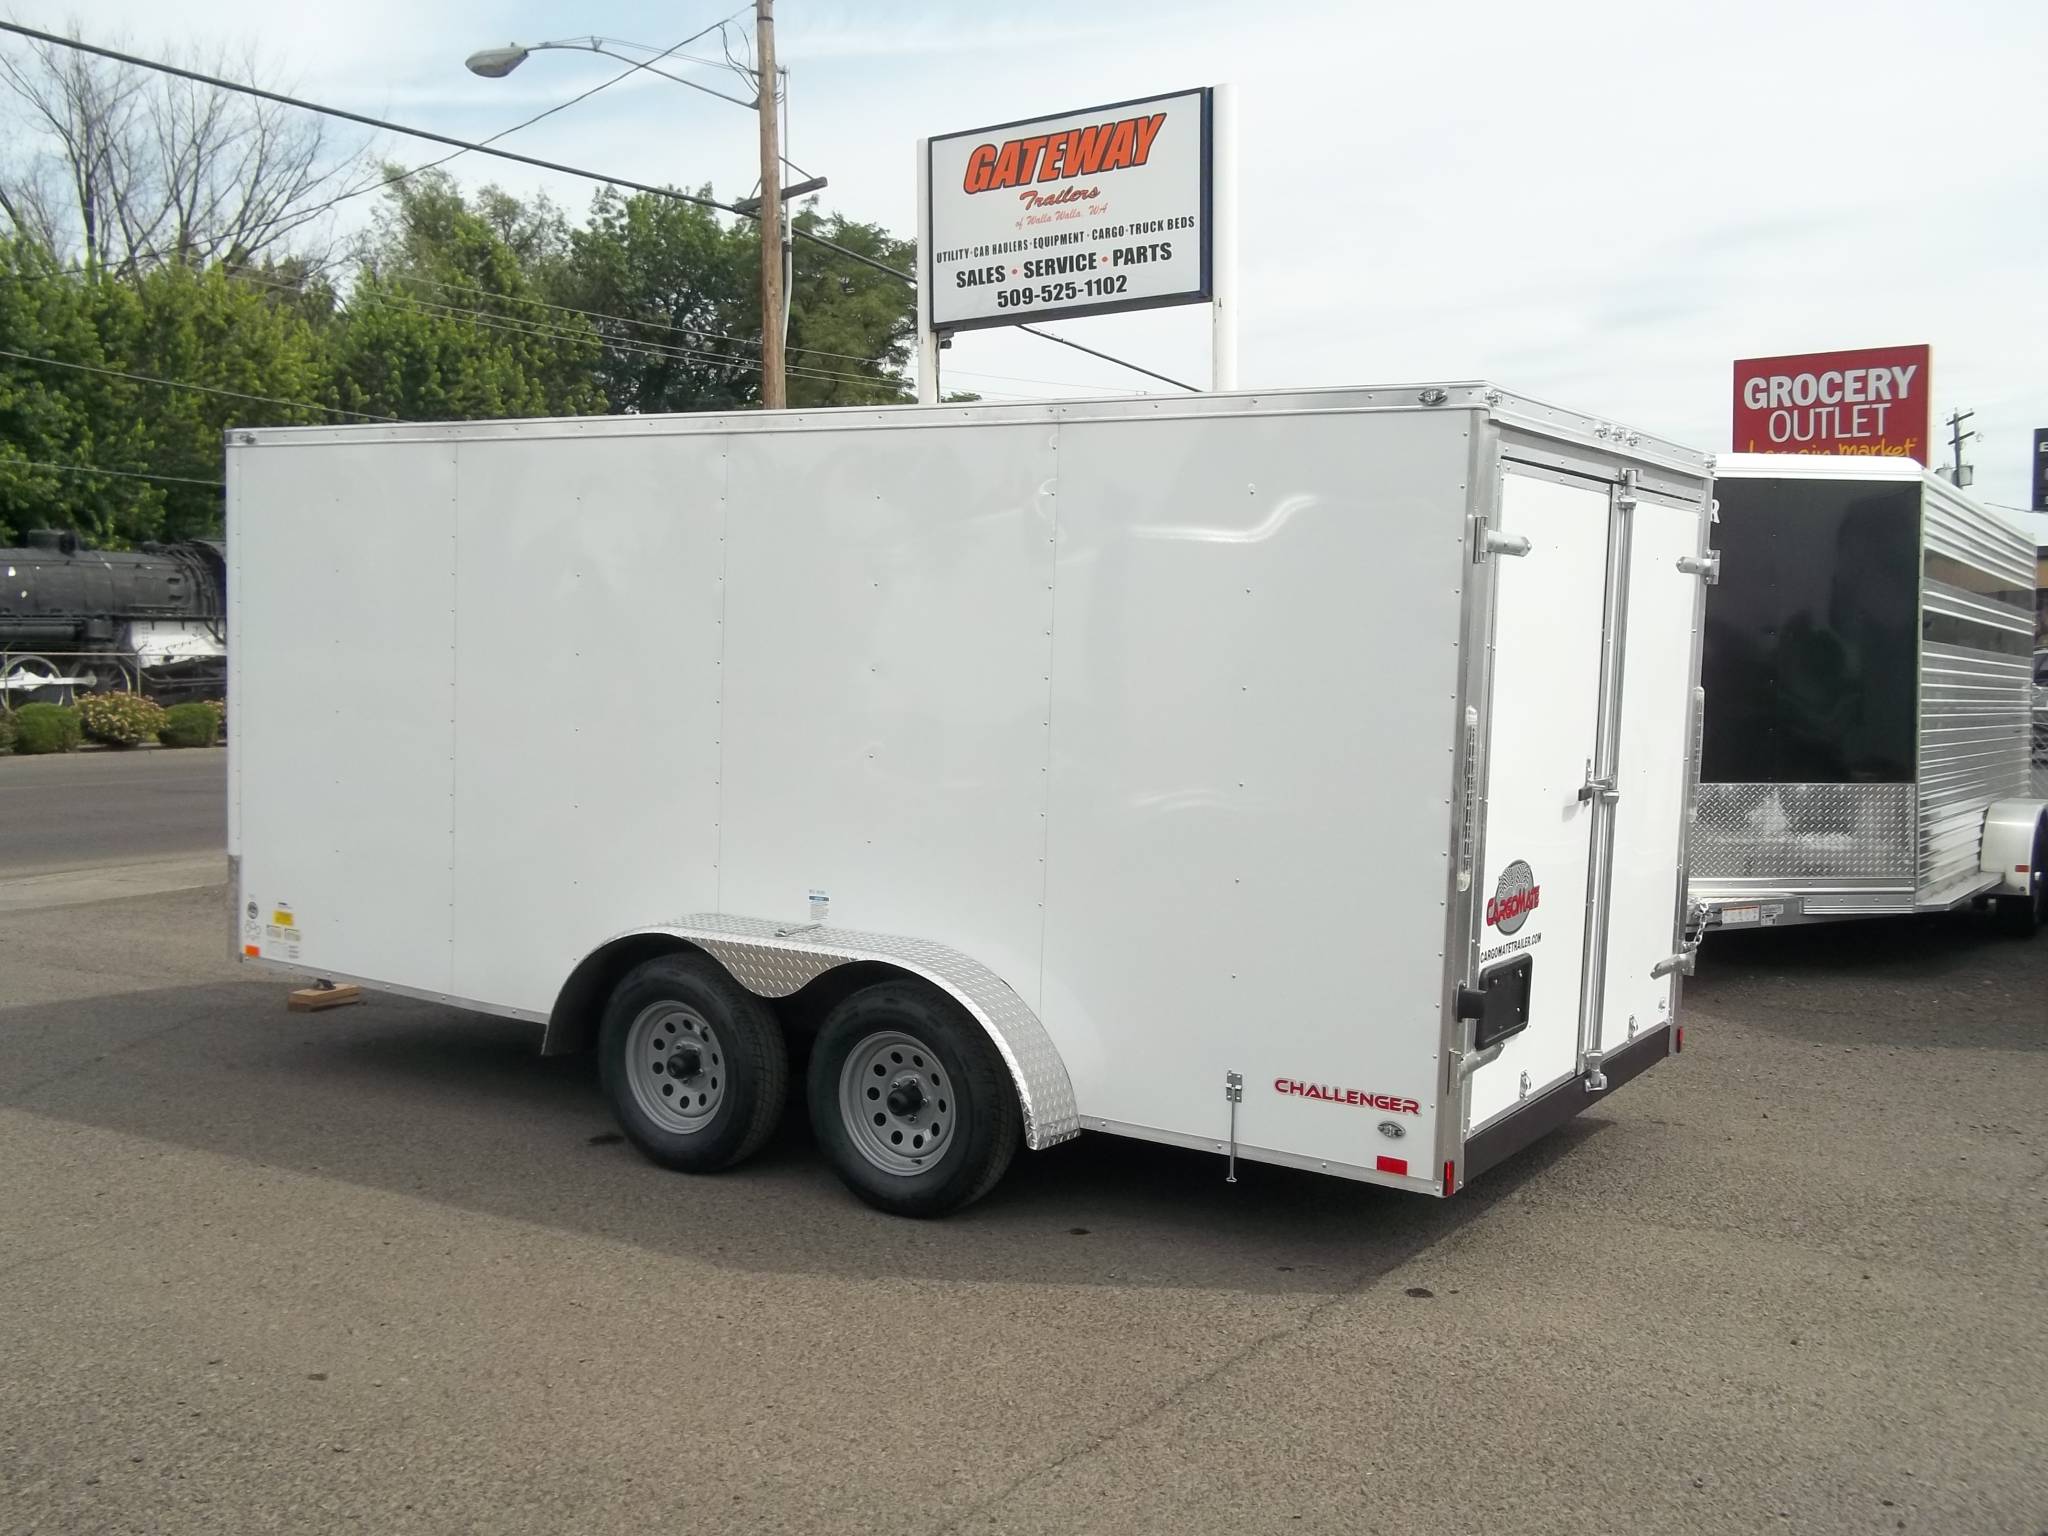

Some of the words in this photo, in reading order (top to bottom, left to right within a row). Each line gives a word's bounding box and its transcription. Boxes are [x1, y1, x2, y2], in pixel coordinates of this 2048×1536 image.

[963, 112, 1167, 195] GATEWAY
[1020, 185, 1100, 211] Trailers
[936, 247, 970, 264] UTILITY
[973, 245, 990, 258] CAR
[992, 239, 1028, 255] HAULERS
[1033, 231, 1085, 249] EQUIPMENT
[1092, 225, 1124, 240] CARGO
[1129, 219, 1164, 235] TRUCK
[1167, 215, 1195, 230] BEDS
[1026, 213, 1052, 226] Walla
[956, 265, 1006, 288] SALES
[1023, 252, 1097, 279] SERVICE
[1112, 242, 1172, 267] PARTS
[997, 275, 1128, 308] 509-525-1102
[1743, 364, 1918, 410] GROCERY
[1768, 403, 1892, 442] OUTLET
[1486, 885, 1540, 927] CARGOMATE
[1480, 932, 1542, 964] CARGOMATETRAILER.COM
[1273, 1077, 1421, 1117] CHALLENGER
